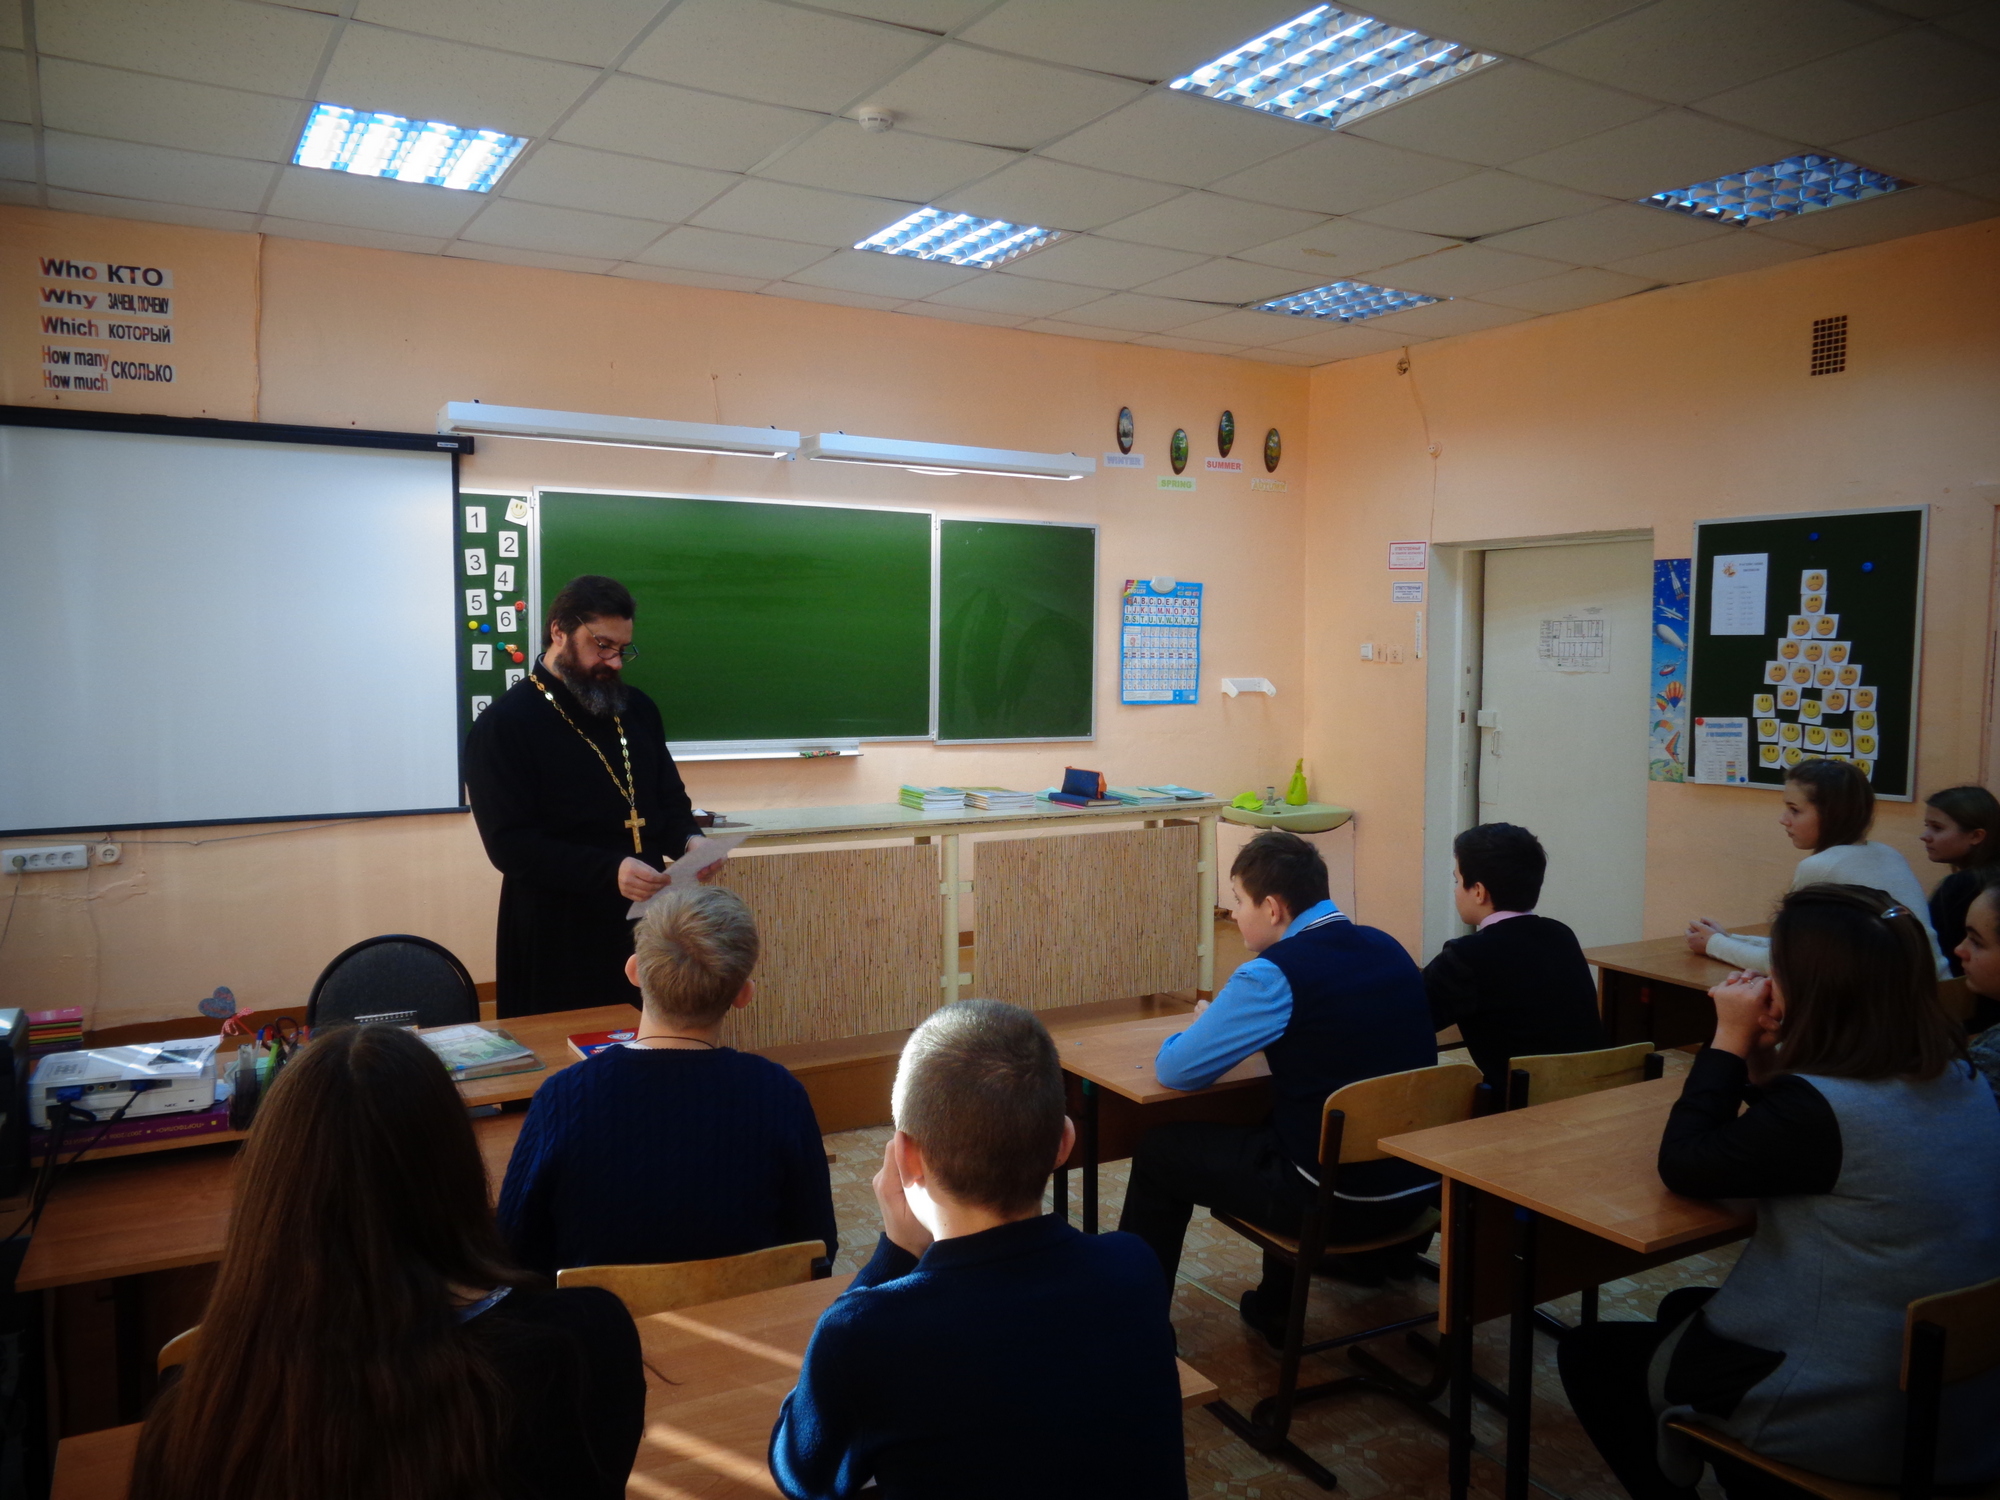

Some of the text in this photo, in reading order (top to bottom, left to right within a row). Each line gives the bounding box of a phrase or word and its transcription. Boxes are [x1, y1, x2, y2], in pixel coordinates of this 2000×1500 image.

[39, 257, 98, 280] Who
[107, 264, 163, 286] КТО
[40, 287, 98, 310] Why
[138, 295, 169, 314] ПОЧЕМУ
[41, 315, 99, 338] Which
[108, 324, 171, 343] КОТОРЫЙ
[42, 345, 110, 372] How many
[111, 360, 173, 382] СКОЛЬКО
[43, 370, 109, 392] How much
[1106, 455, 1141, 466] WINTER
[1206, 460, 1242, 471] SUMMER
[1160, 479, 1193, 489] SPRING
[470, 512, 479, 528] 1
[503, 537, 515, 553] 2
[469, 554, 482, 571] 3
[497, 571, 509, 587] 4
[470, 594, 483, 611] 5
[500, 611, 512, 627] 6
[478, 650, 488, 666] 7
